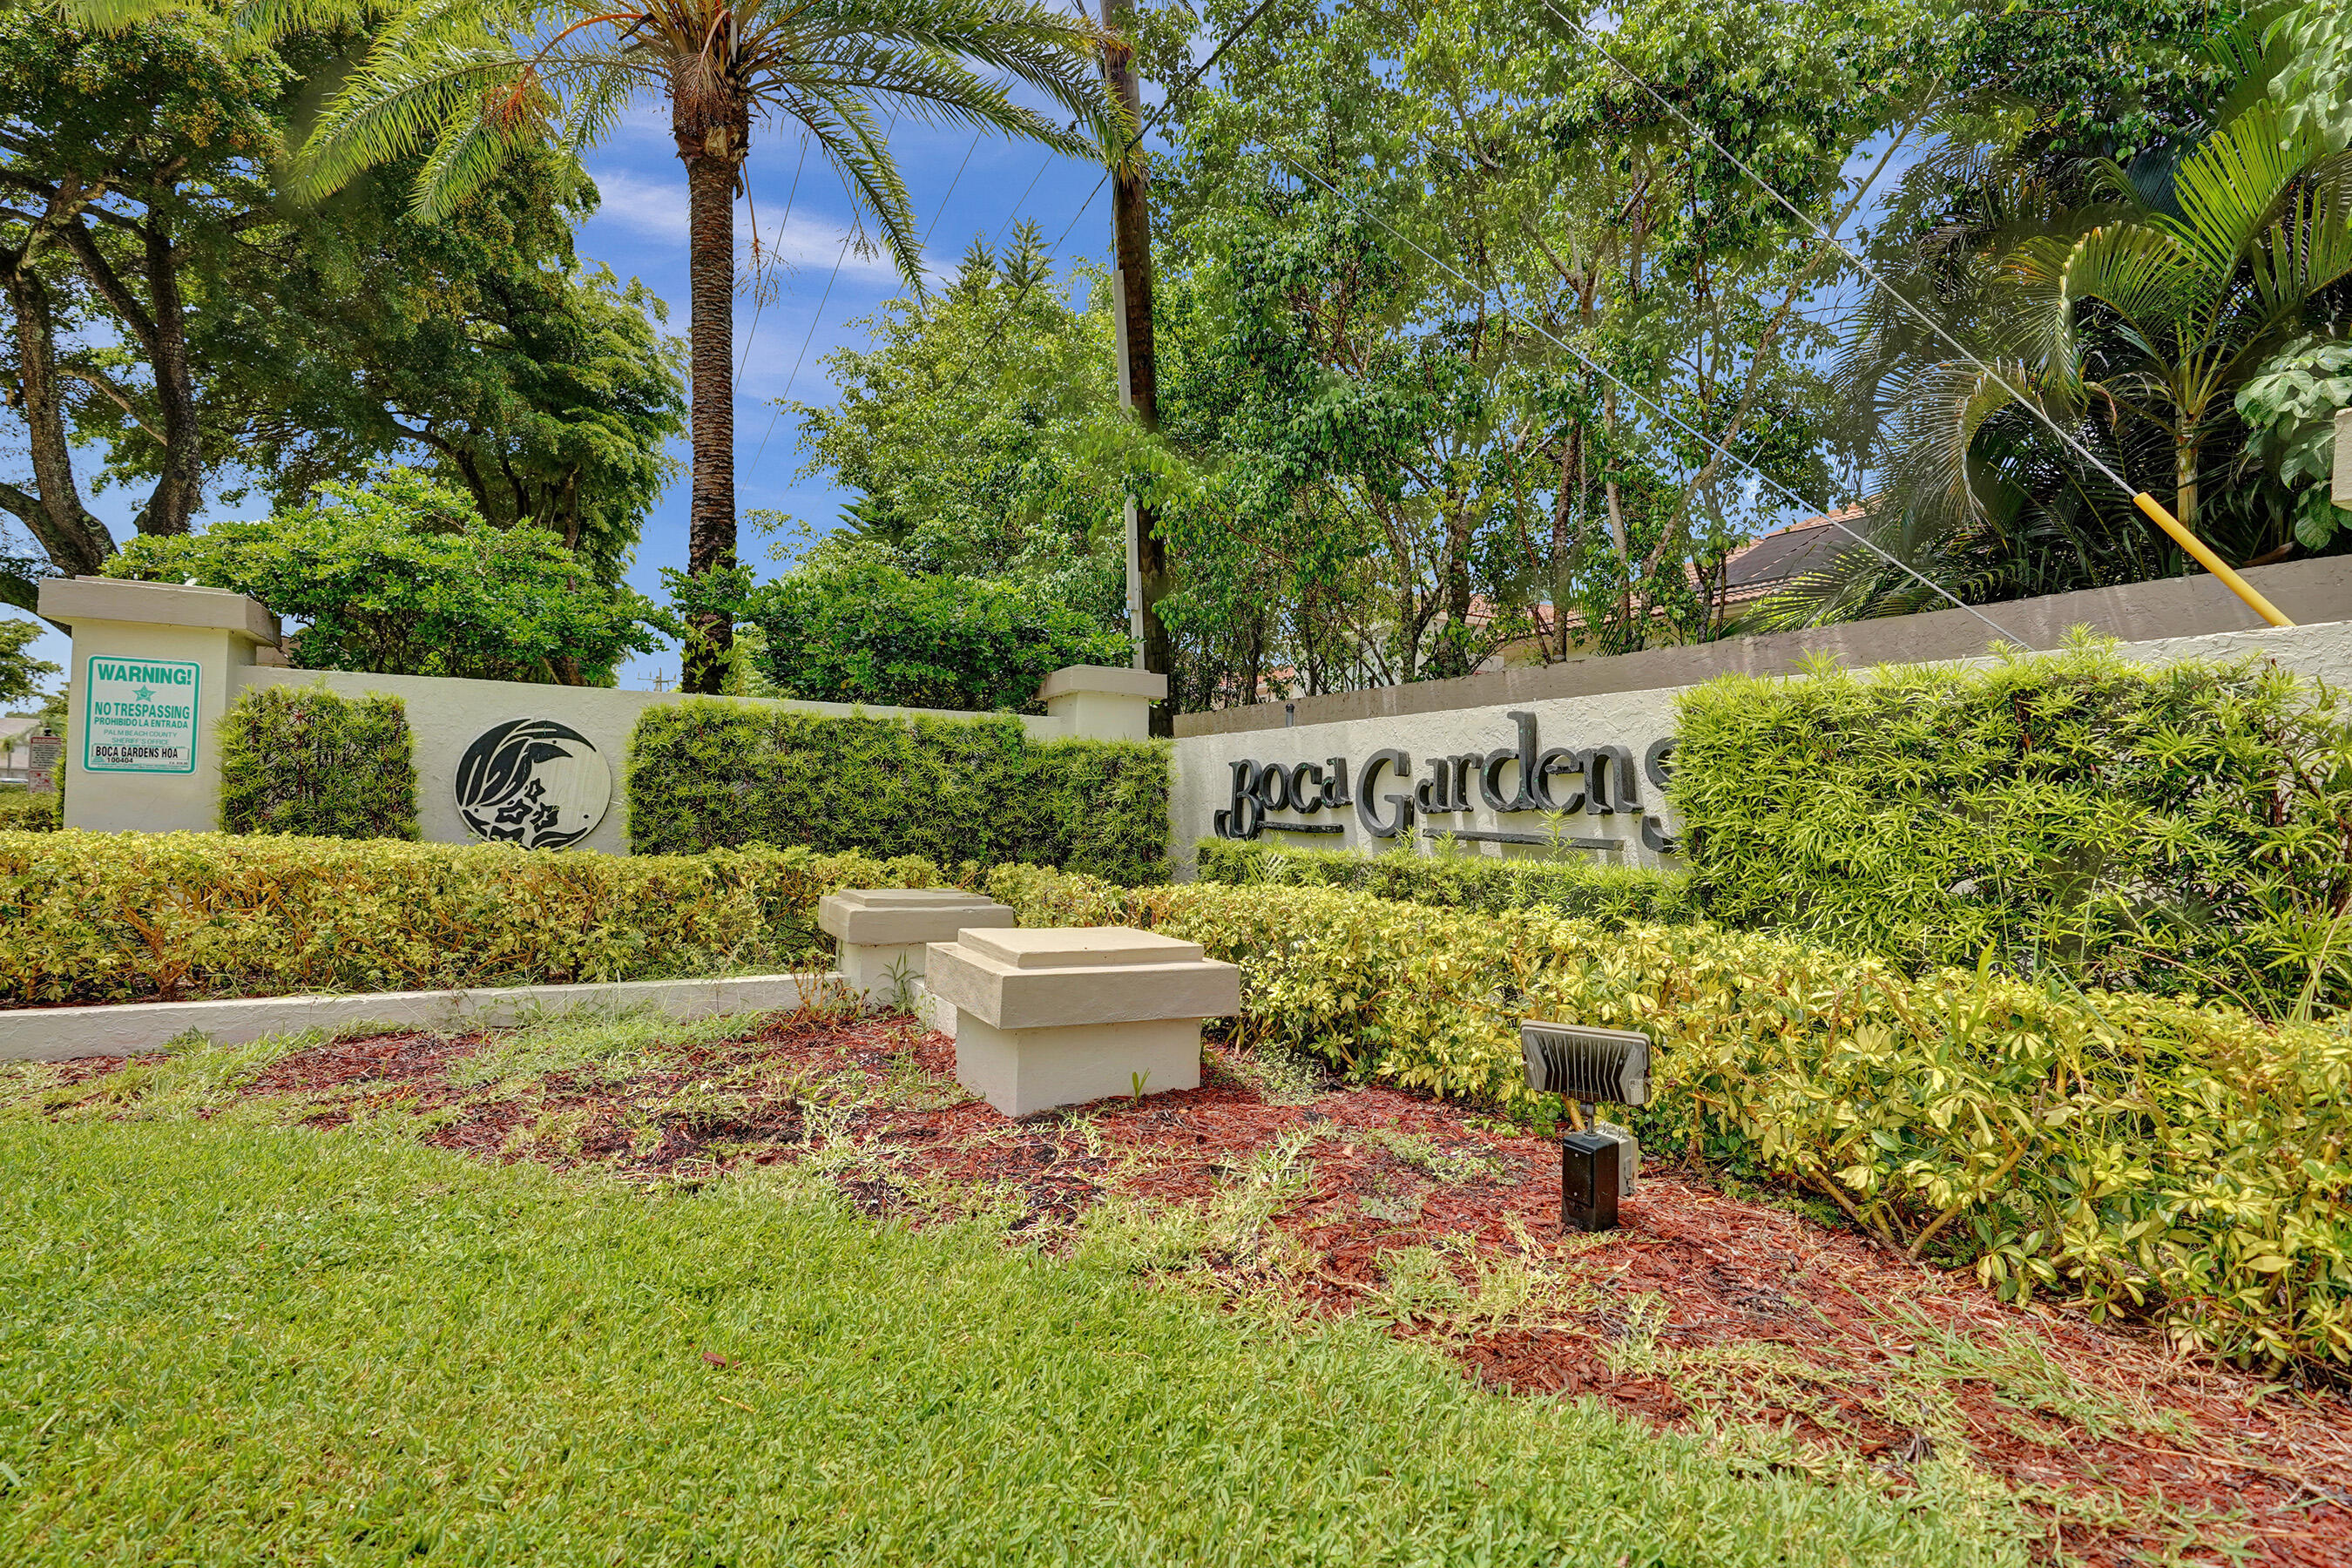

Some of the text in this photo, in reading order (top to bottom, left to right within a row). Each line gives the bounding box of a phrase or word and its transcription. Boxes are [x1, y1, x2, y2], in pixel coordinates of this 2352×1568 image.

[98, 664, 192, 685] WARNING!
[94, 701, 190, 720] NO TRESPASSING
[94, 717, 188, 729] PROHIBIDO LA ENTRADA
[96, 746, 118, 757] BOCA
[121, 747, 159, 758] GARDENS
[161, 747, 179, 759] HOA
[1214, 758, 1354, 840] Boca
